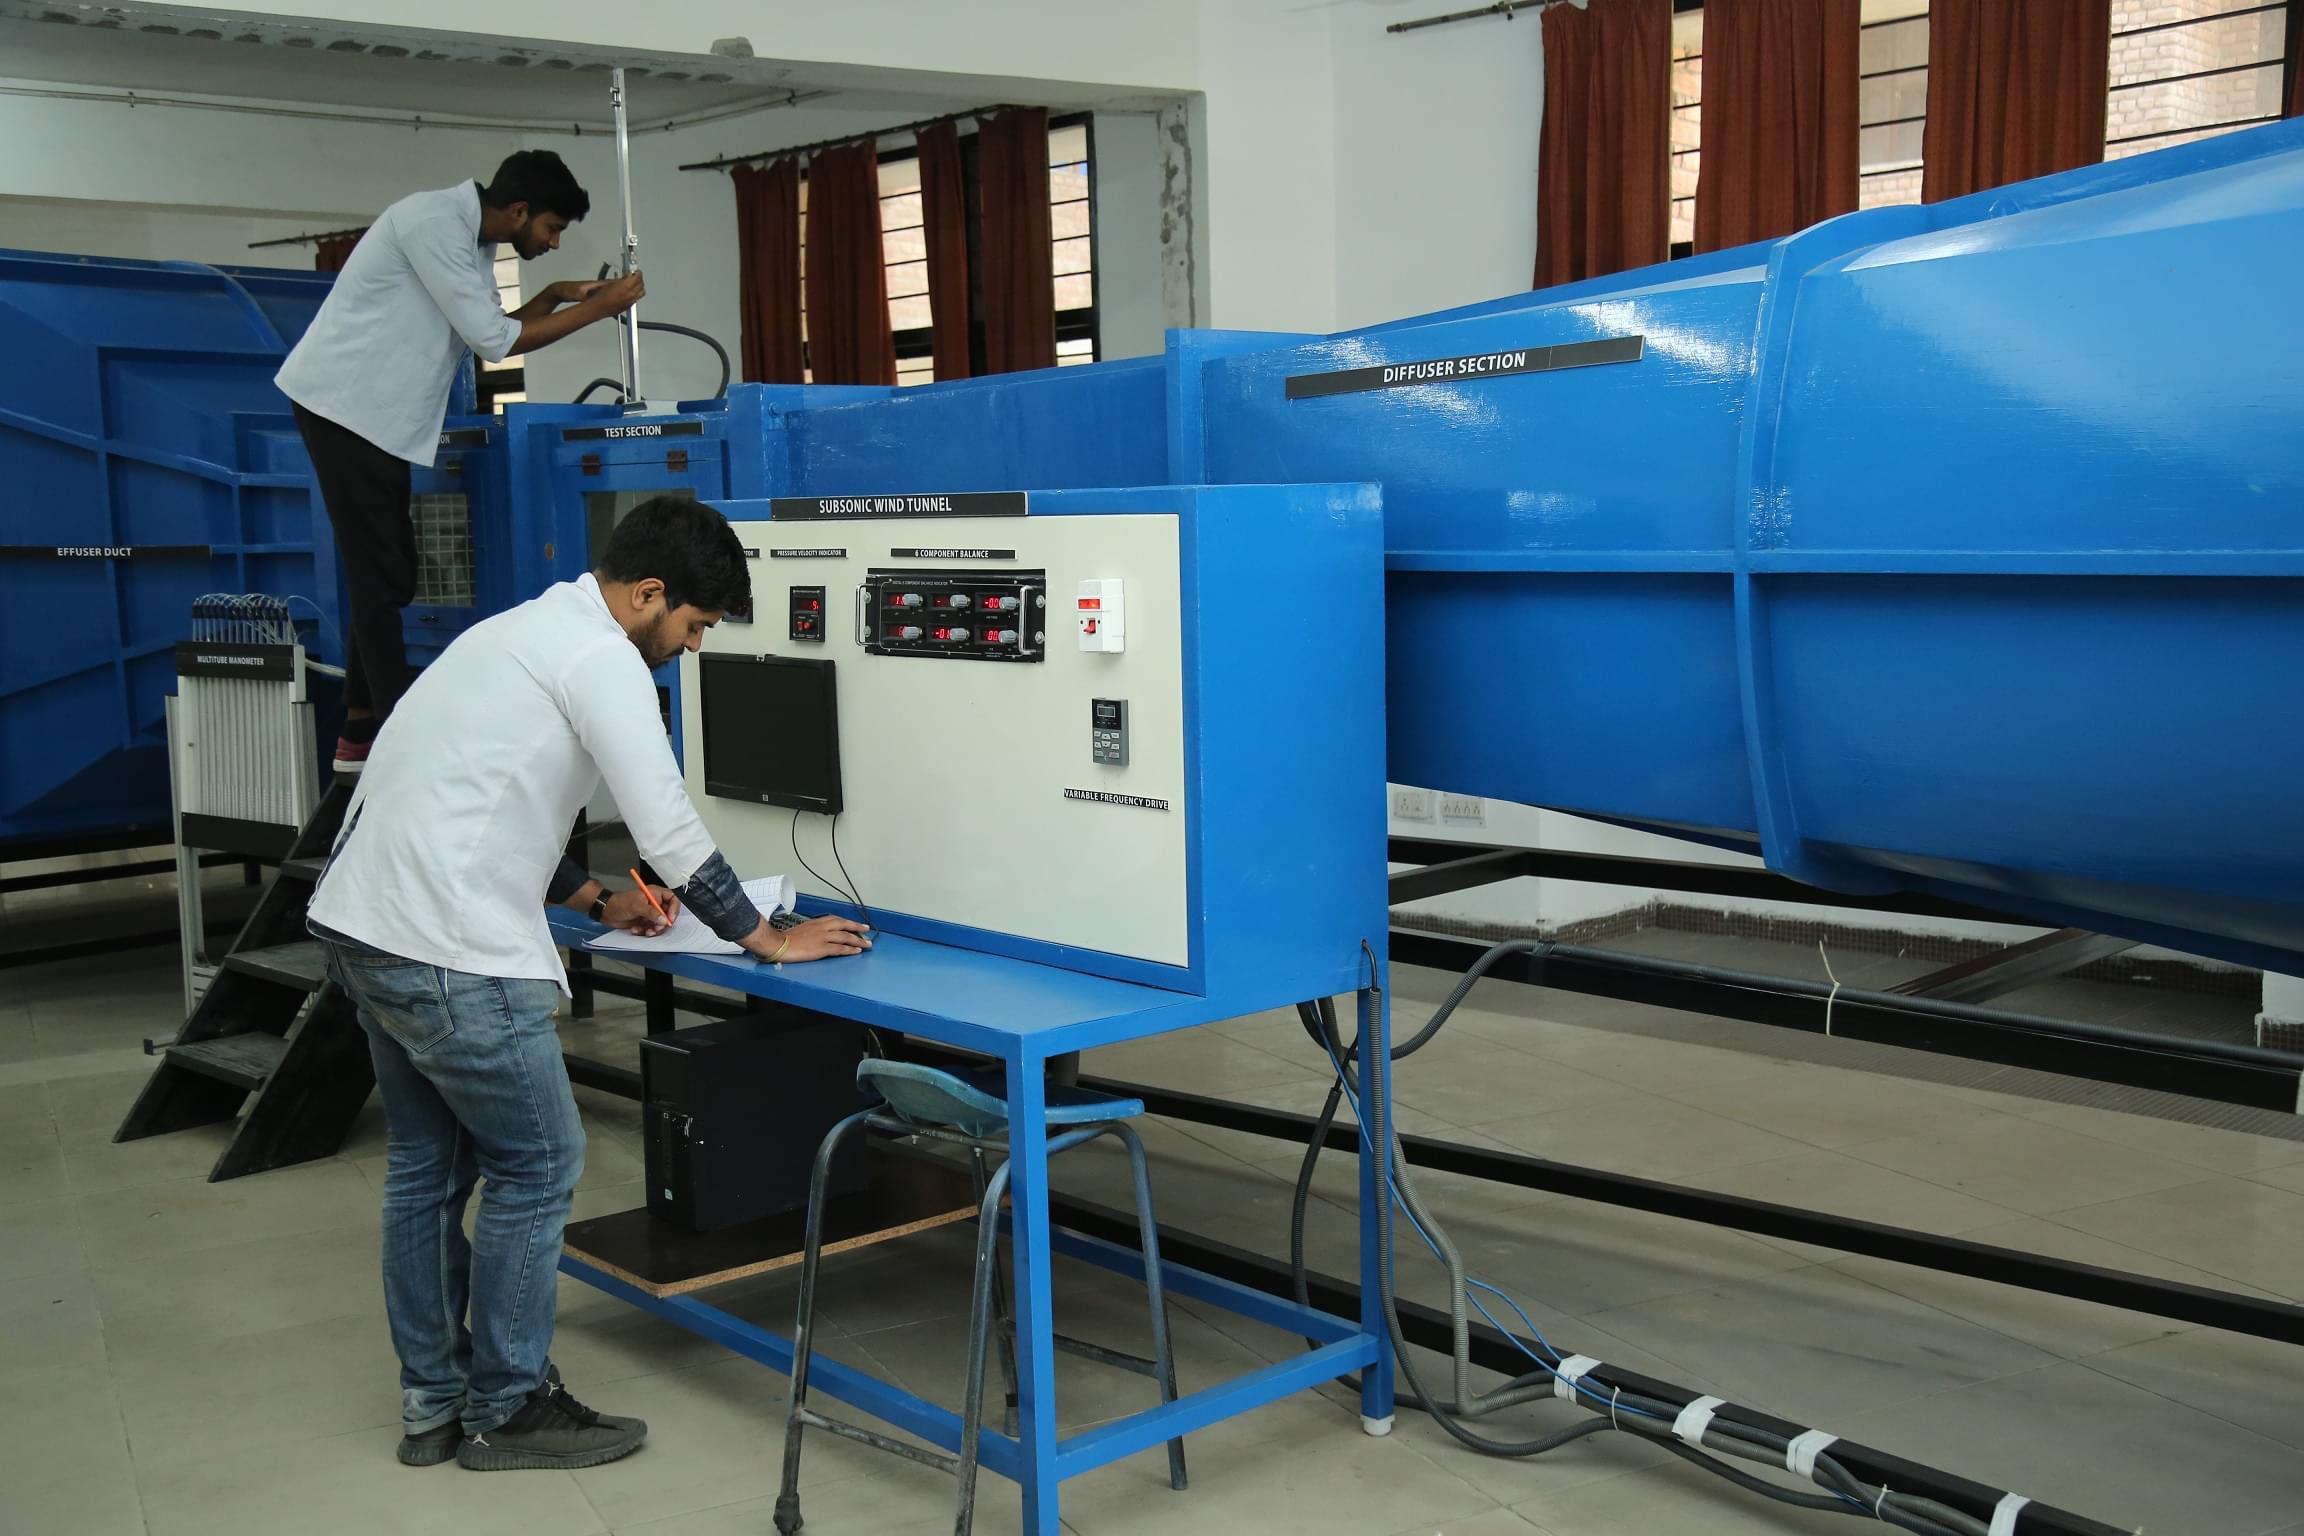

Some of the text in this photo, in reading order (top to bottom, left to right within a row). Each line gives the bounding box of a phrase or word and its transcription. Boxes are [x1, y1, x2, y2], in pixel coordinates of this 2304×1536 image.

[1383, 352, 1526, 382] DIFFUSER SECTION
[604, 425, 662, 438] TEST SECTION
[819, 497, 952, 513] SUBSONIC WIND TUNNEL
[57, 547, 132, 556] EFFUSER DUCT
[920, 549, 959, 558] COMPONENT
[960, 550, 989, 558] BALANCE
[197, 655, 264, 666] MULTITUBE MANOMETER
[1064, 789, 1168, 810] VARIABLE FREQUENCY DRIVE
